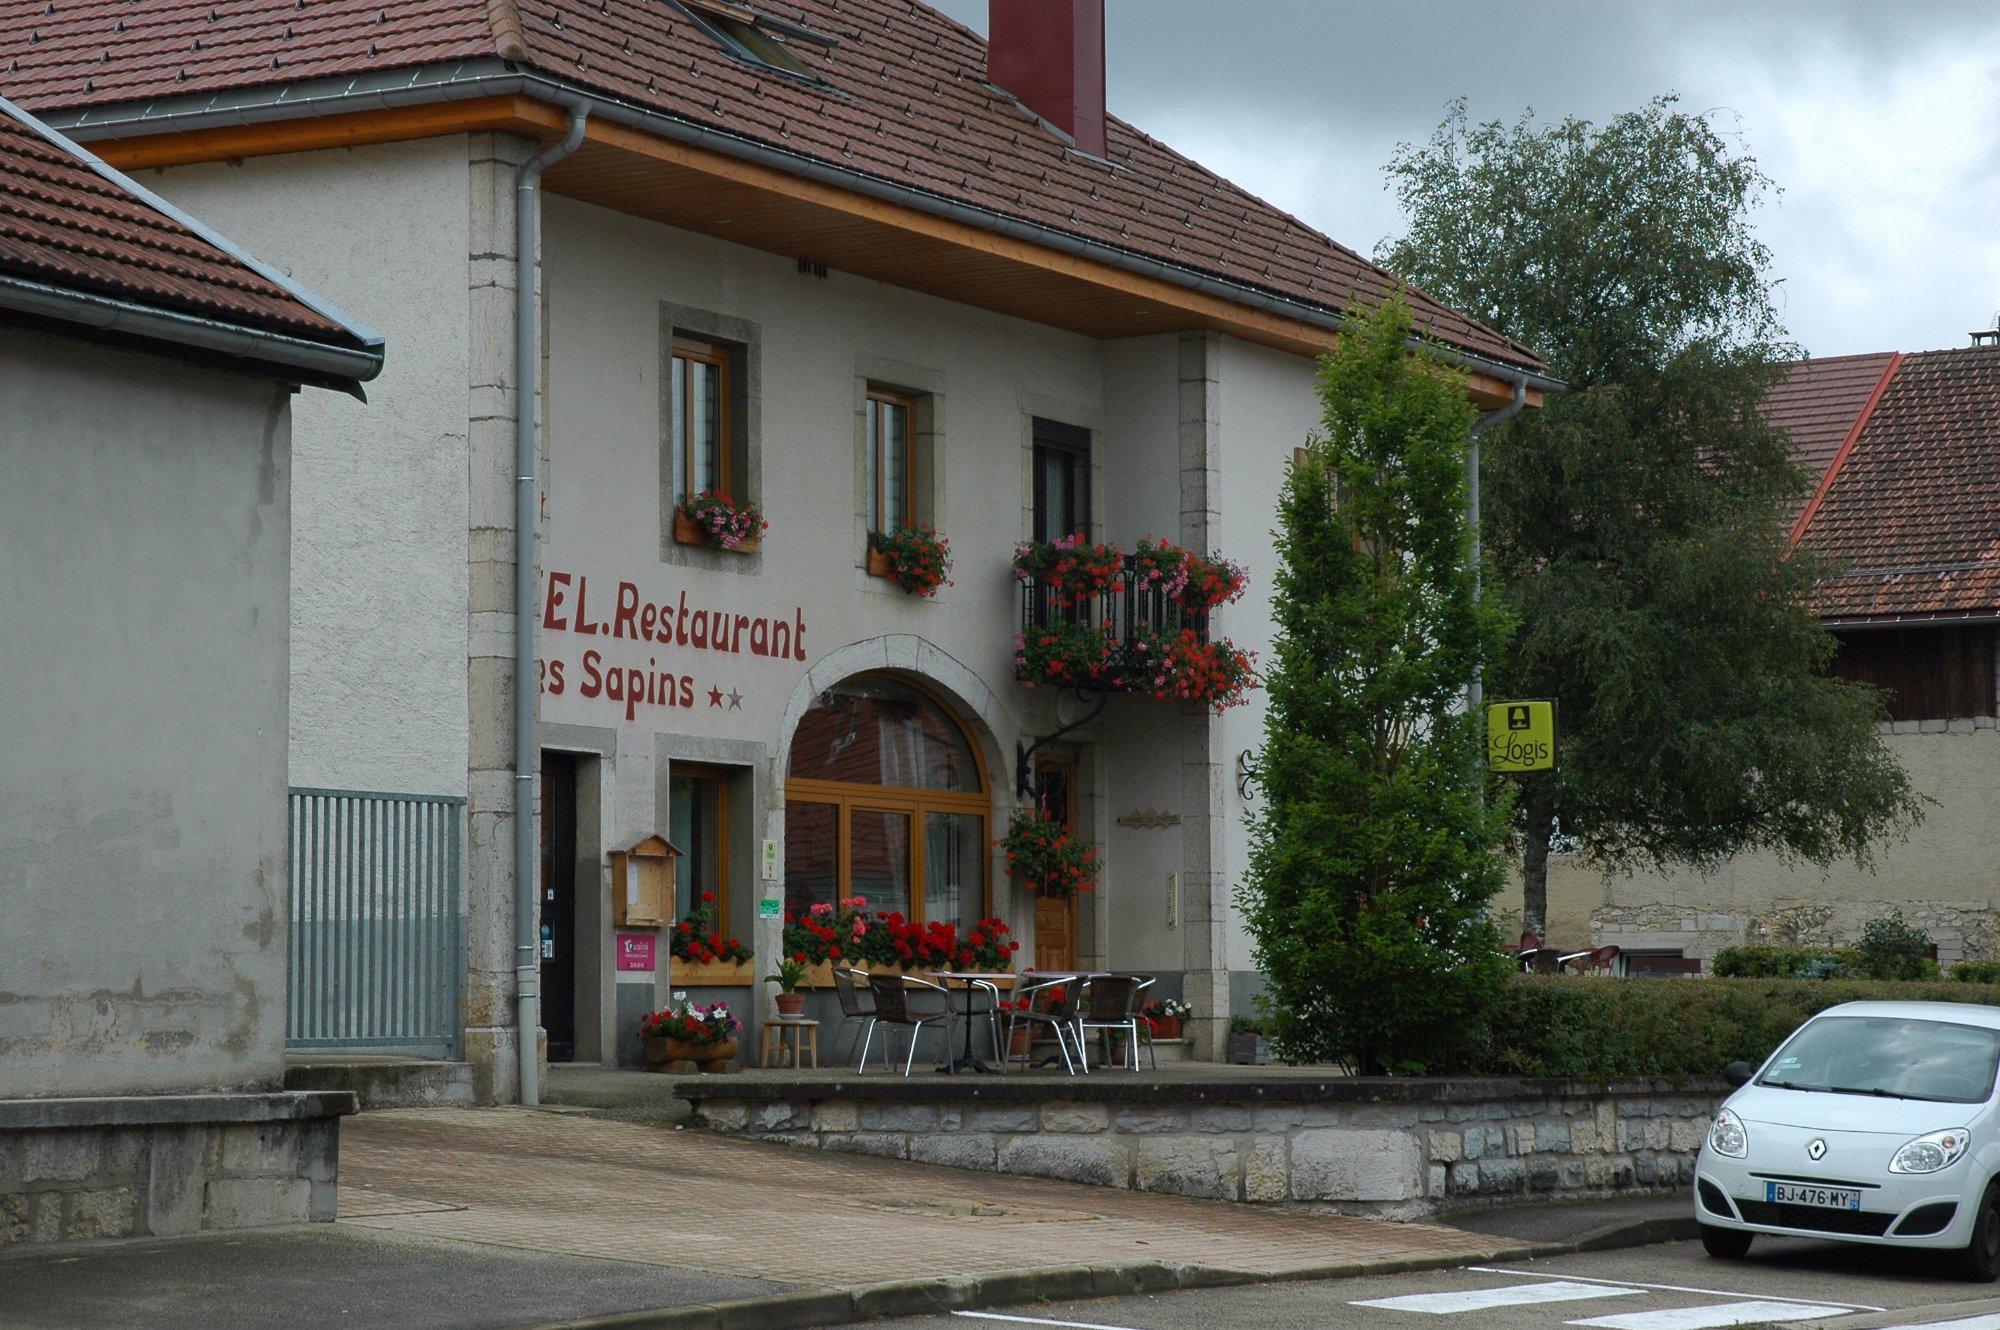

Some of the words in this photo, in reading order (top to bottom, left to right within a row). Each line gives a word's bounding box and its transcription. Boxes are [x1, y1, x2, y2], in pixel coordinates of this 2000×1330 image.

[579, 649, 695, 721] Sapins
[1491, 731, 1548, 766] Logis
[1776, 1186, 1849, 1207] BJ-476-MY
